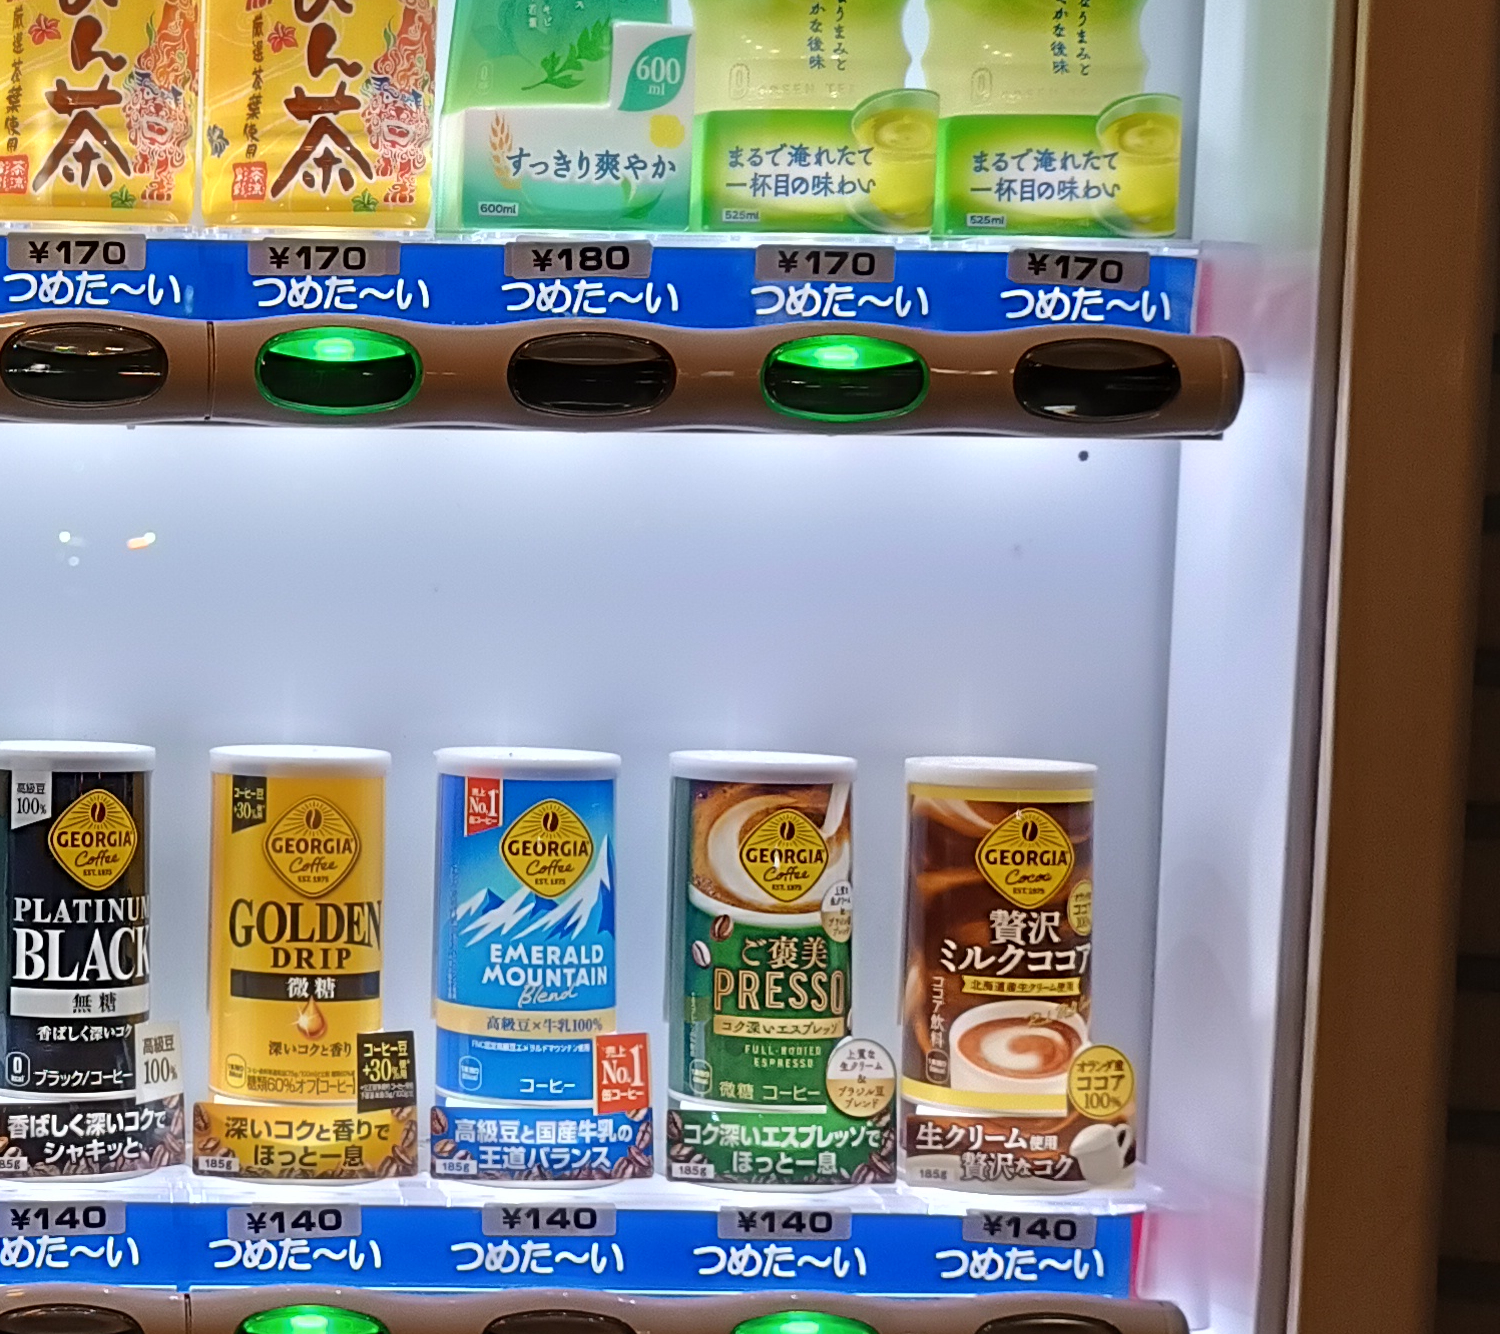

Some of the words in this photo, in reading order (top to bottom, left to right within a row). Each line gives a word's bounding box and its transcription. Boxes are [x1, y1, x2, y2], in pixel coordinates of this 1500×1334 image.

[636, 57, 681, 87] 600
[506, 146, 677, 181] すっきり爽やか
[727, 143, 876, 168] まるで淹れたて
[726, 172, 877, 198] 一杯目の味わい
[29, 239, 127, 265] ¥170
[269, 243, 367, 270] ¥170
[532, 246, 630, 272] ¥180
[778, 249, 876, 276] ¥170
[1027, 252, 1123, 283] ¥170
[16, 797, 47, 817] 100%
[56, 831, 132, 849] GEORGIA
[229, 898, 382, 949] GOLDEN
[270, 947, 352, 970] DRIP
[489, 944, 604, 965] EMERALD
[739, 936, 829, 968] ご褒美
[939, 943, 1092, 976] ミルクココア
[285, 976, 336, 999] 微糖
[481, 965, 608, 988] MOUNTAIN
[71, 993, 117, 1013] 無糖
[714, 970, 844, 1013] PRESSO
[142, 1033, 175, 1053] 高級豆
[519, 1078, 575, 1094] コーヒー
[1076, 1074, 1122, 1091] ココア
[7, 1108, 167, 1139] 香ばしく深いコクで
[225, 1116, 391, 1142] 深いコクと香りで
[454, 1117, 633, 1146] 高級豆と国産牛乳の
[683, 1122, 880, 1149] コク深いエスプレッソで
[253, 1143, 365, 1169] ほっと一息
[478, 1146, 612, 1172] 王道バランス
[10, 1205, 108, 1231] ¥140
[246, 1209, 343, 1233] ¥140
[502, 1207, 598, 1231] ¥140
[738, 1210, 834, 1235] ¥140
[983, 1214, 1077, 1242] ¥140
